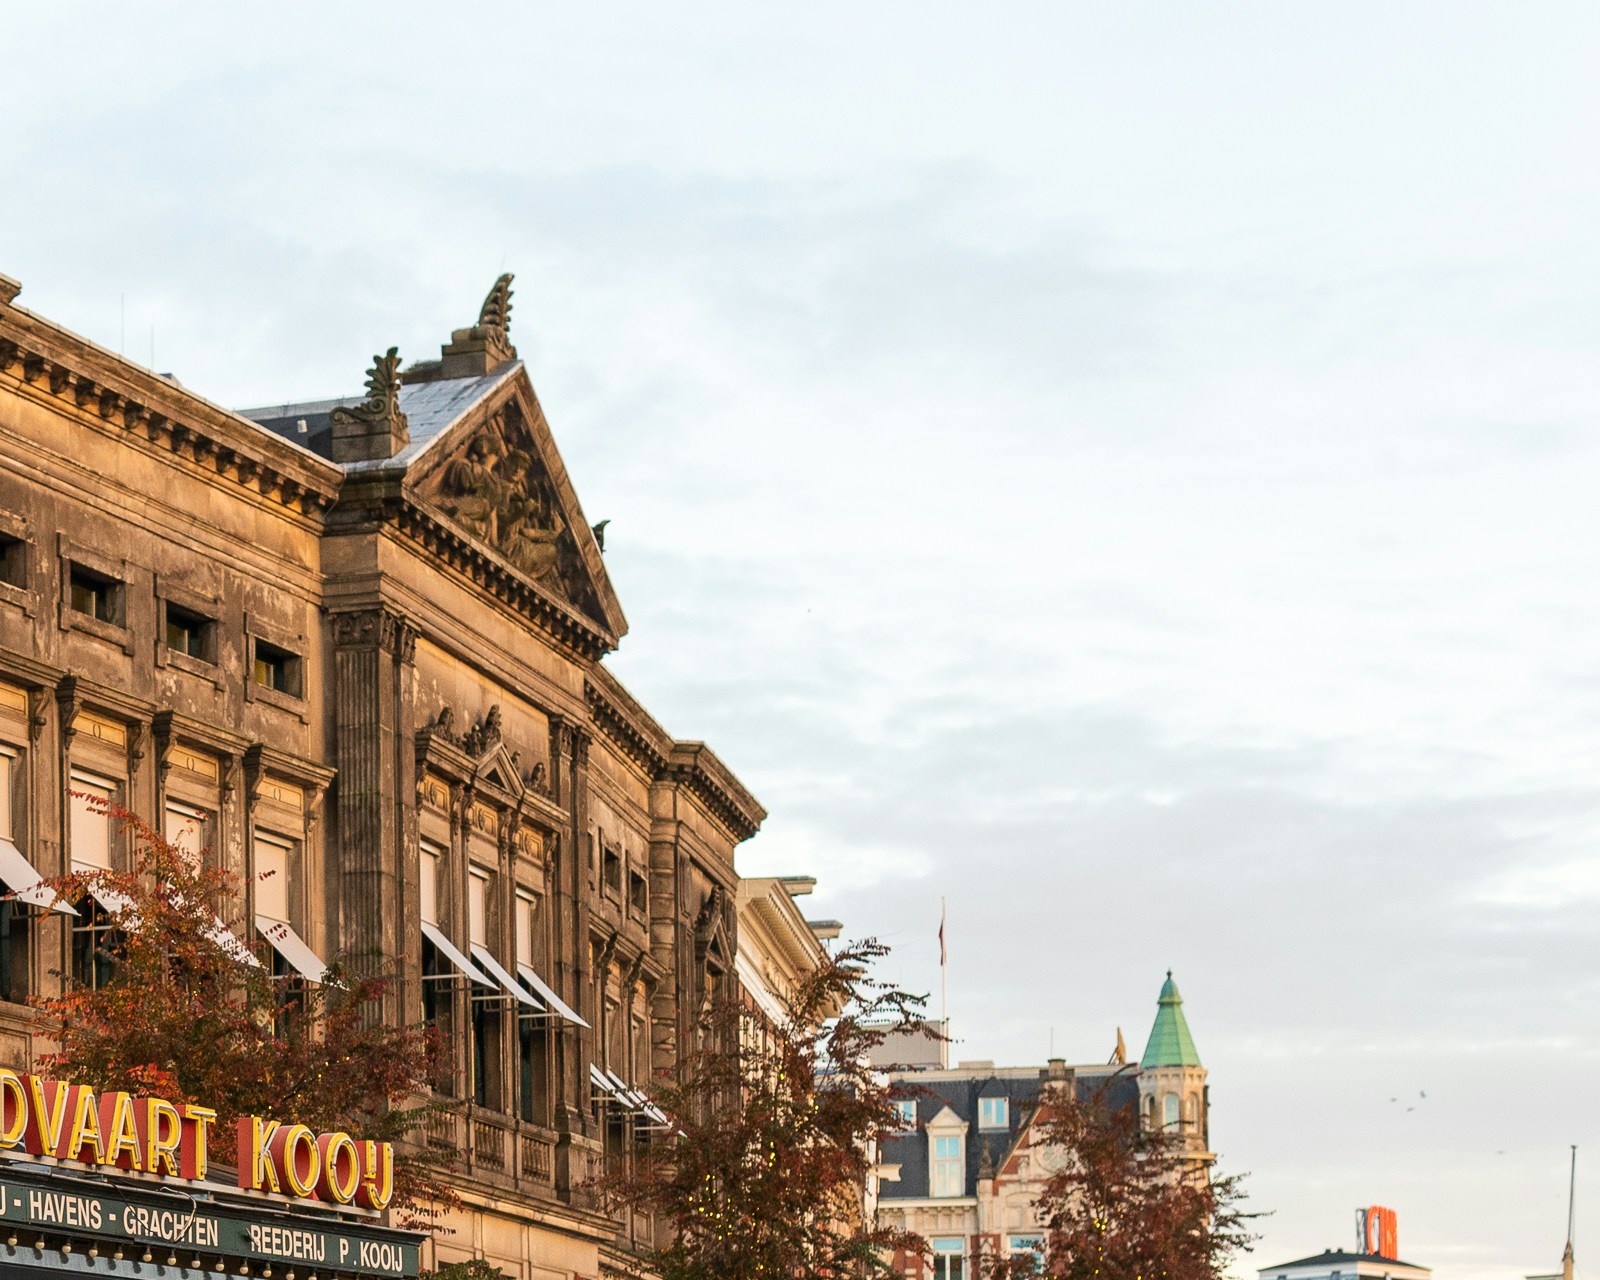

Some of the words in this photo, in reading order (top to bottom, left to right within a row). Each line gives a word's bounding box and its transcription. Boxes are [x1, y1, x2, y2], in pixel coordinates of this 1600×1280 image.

[28, 1190, 103, 1230] HAVENS
[123, 1205, 219, 1247] GRACHTEN
[250, 1224, 326, 1262] REEDERIJ
[360, 1241, 404, 1272] KOOIJ
